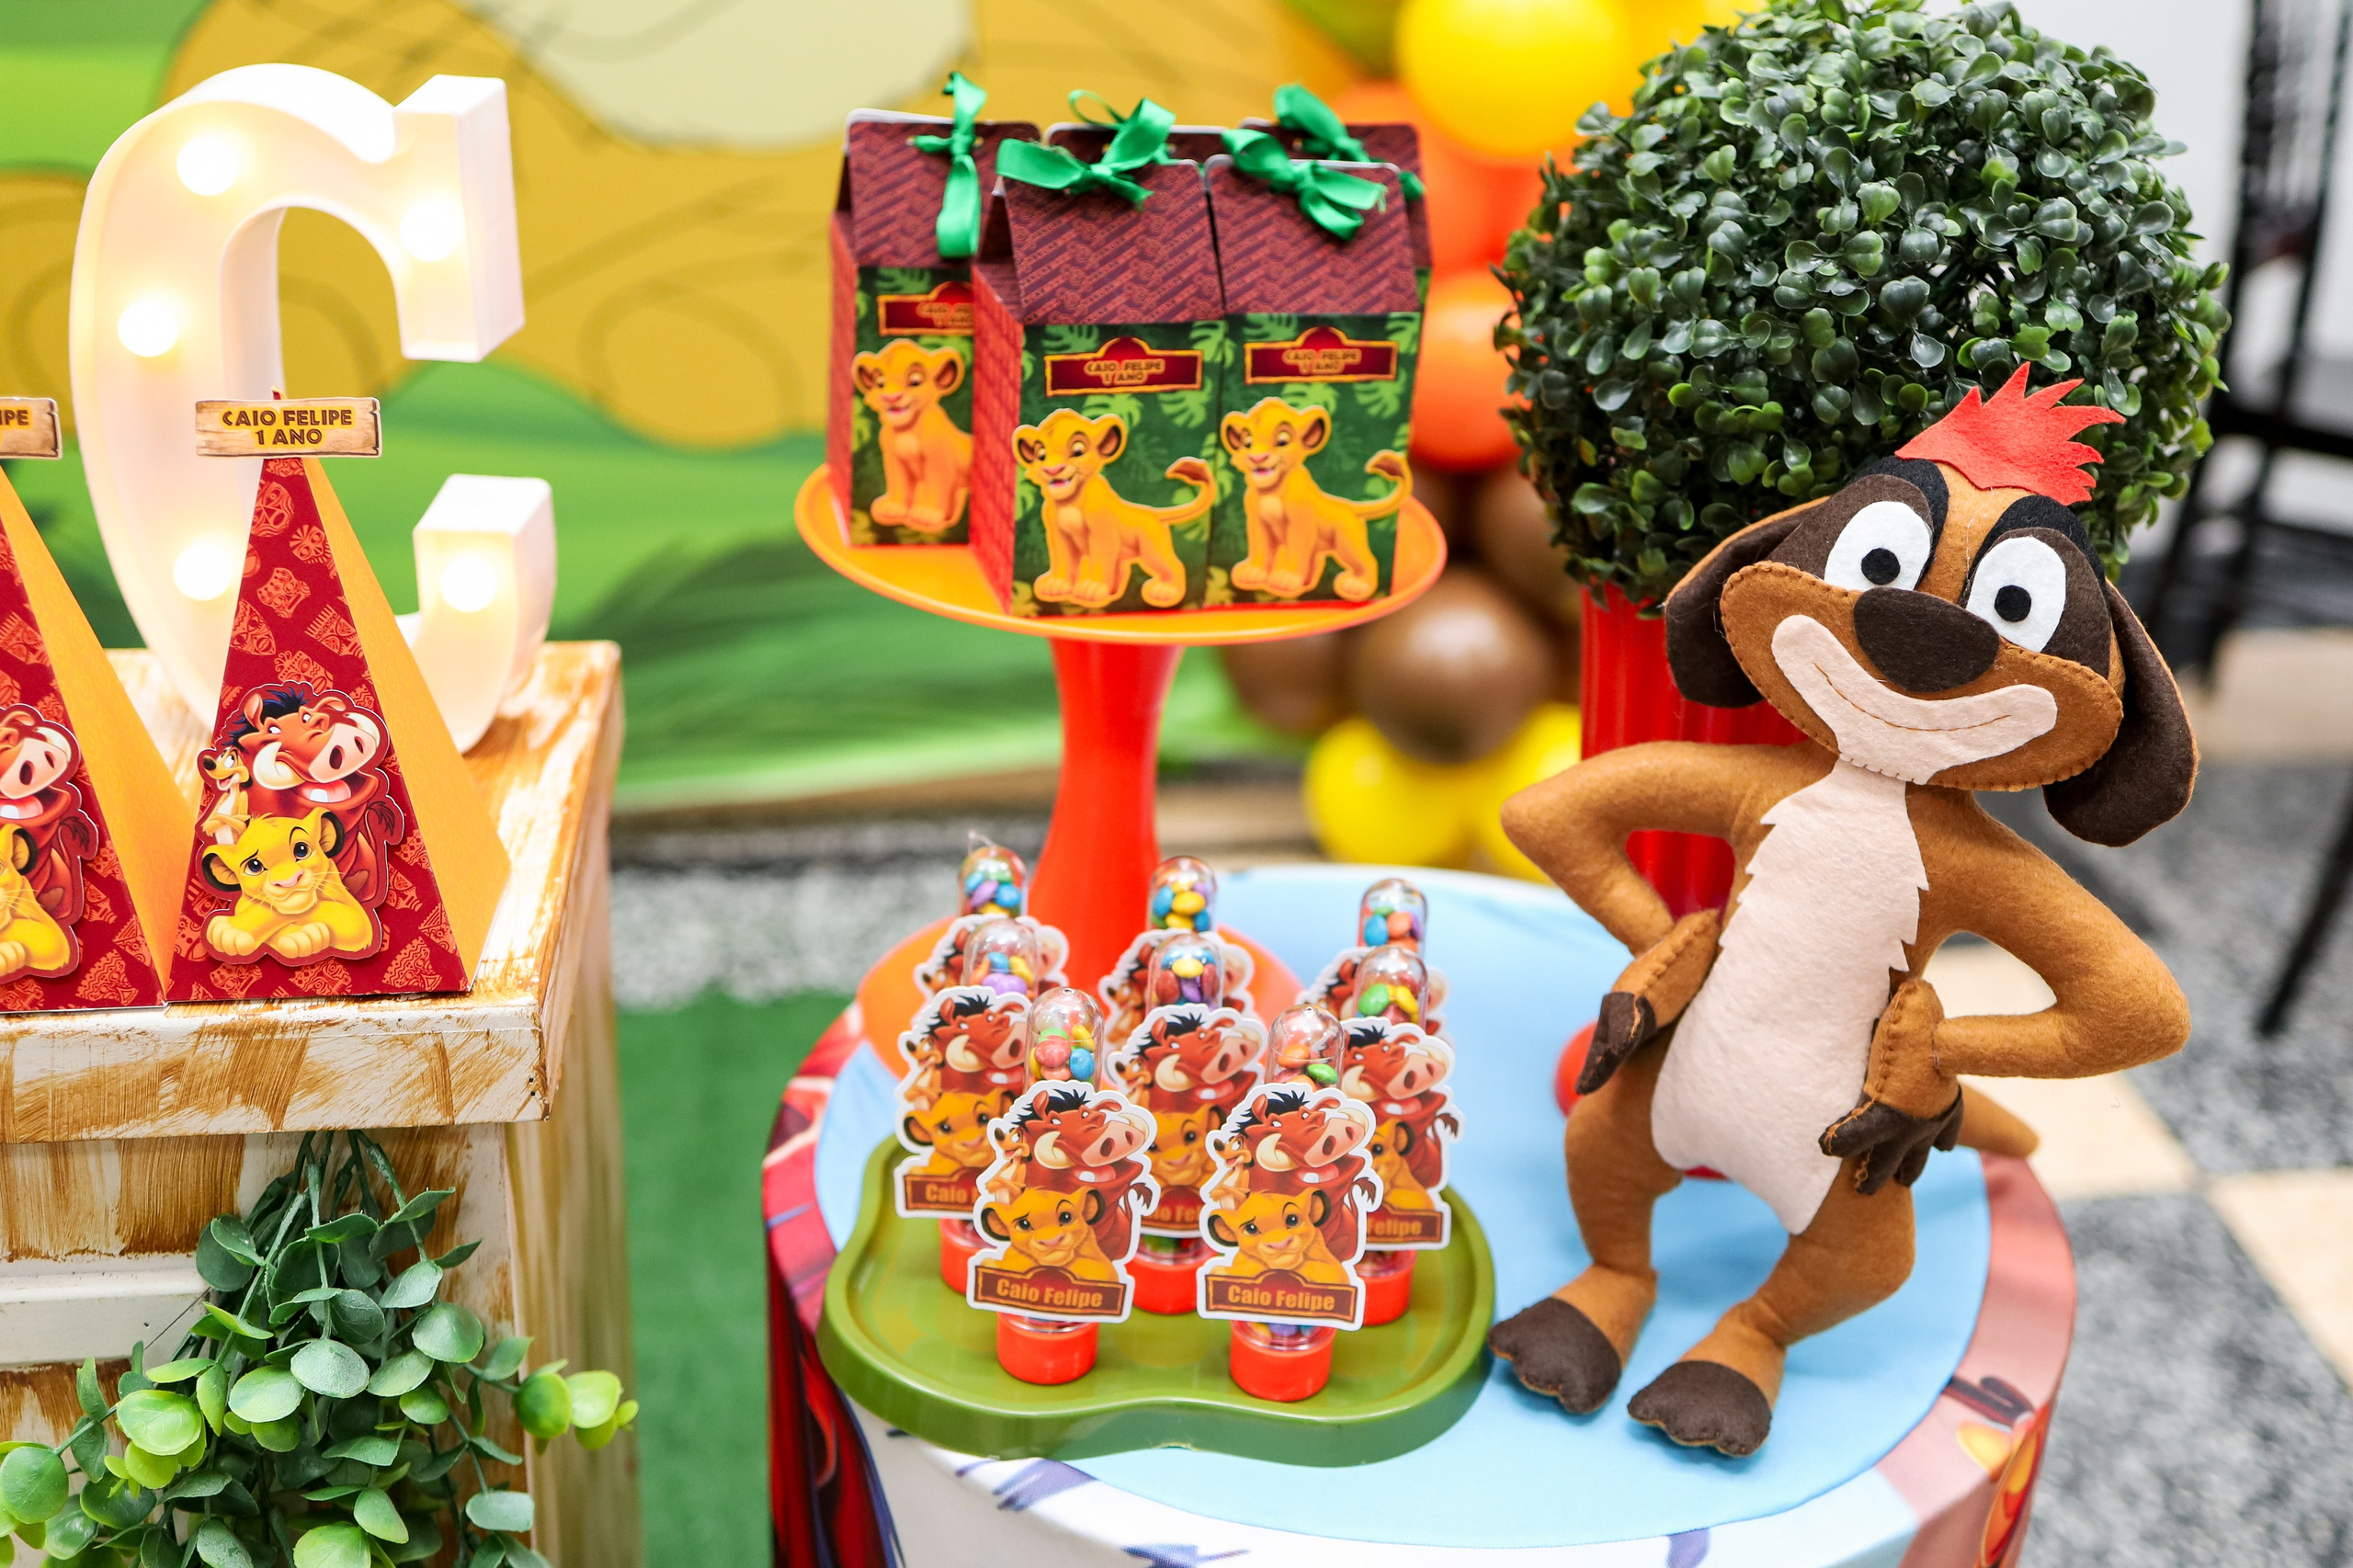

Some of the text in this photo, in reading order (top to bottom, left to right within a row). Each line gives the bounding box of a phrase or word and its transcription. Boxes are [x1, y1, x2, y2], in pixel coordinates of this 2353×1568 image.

[222, 409, 353, 426] CAIO FELIPE
[255, 428, 323, 445] 1 ANO
[925, 1183, 968, 1204] Caio
[996, 1278, 1103, 1309] Caio Felipe
[1227, 1284, 1336, 1312] Caio Felipe
